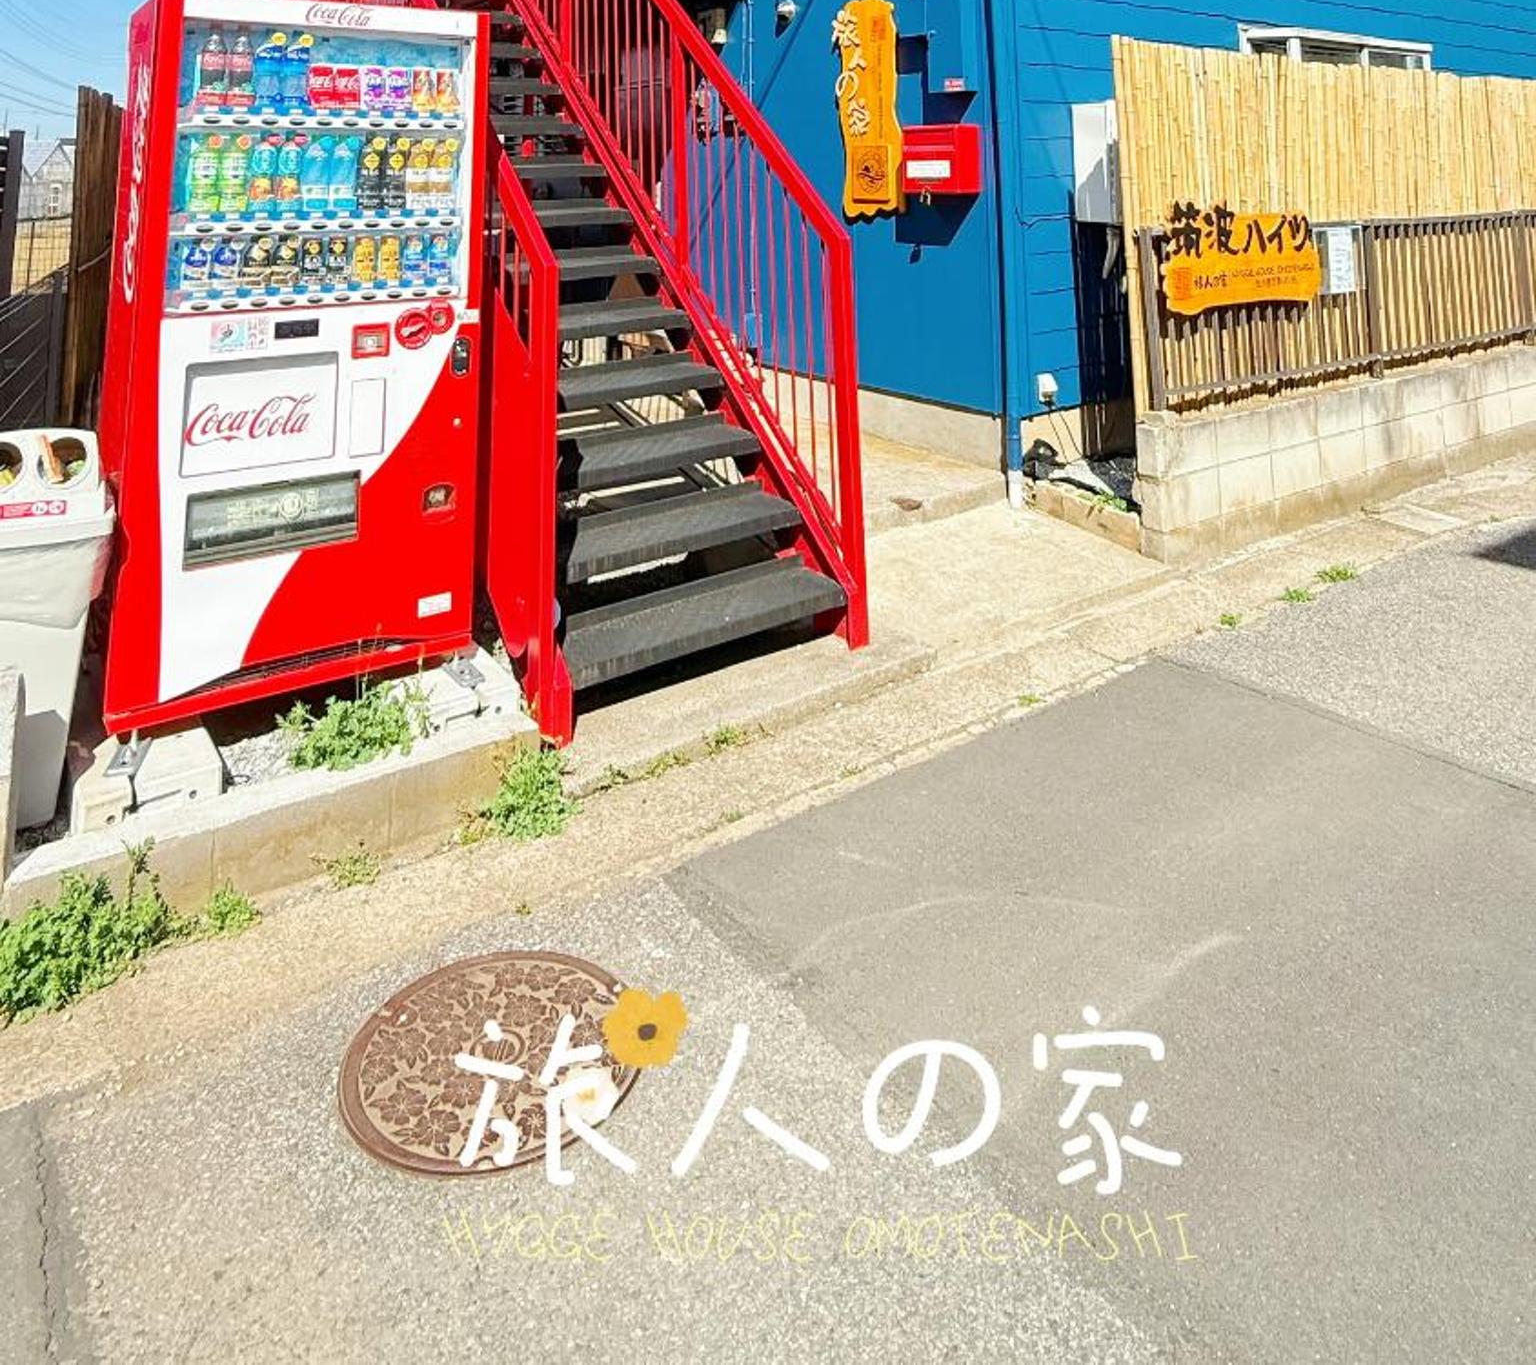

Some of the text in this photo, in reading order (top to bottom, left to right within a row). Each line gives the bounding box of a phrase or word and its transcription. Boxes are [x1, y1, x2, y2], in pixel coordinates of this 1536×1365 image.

[1168, 199, 1310, 259] 筑波ハイツ
